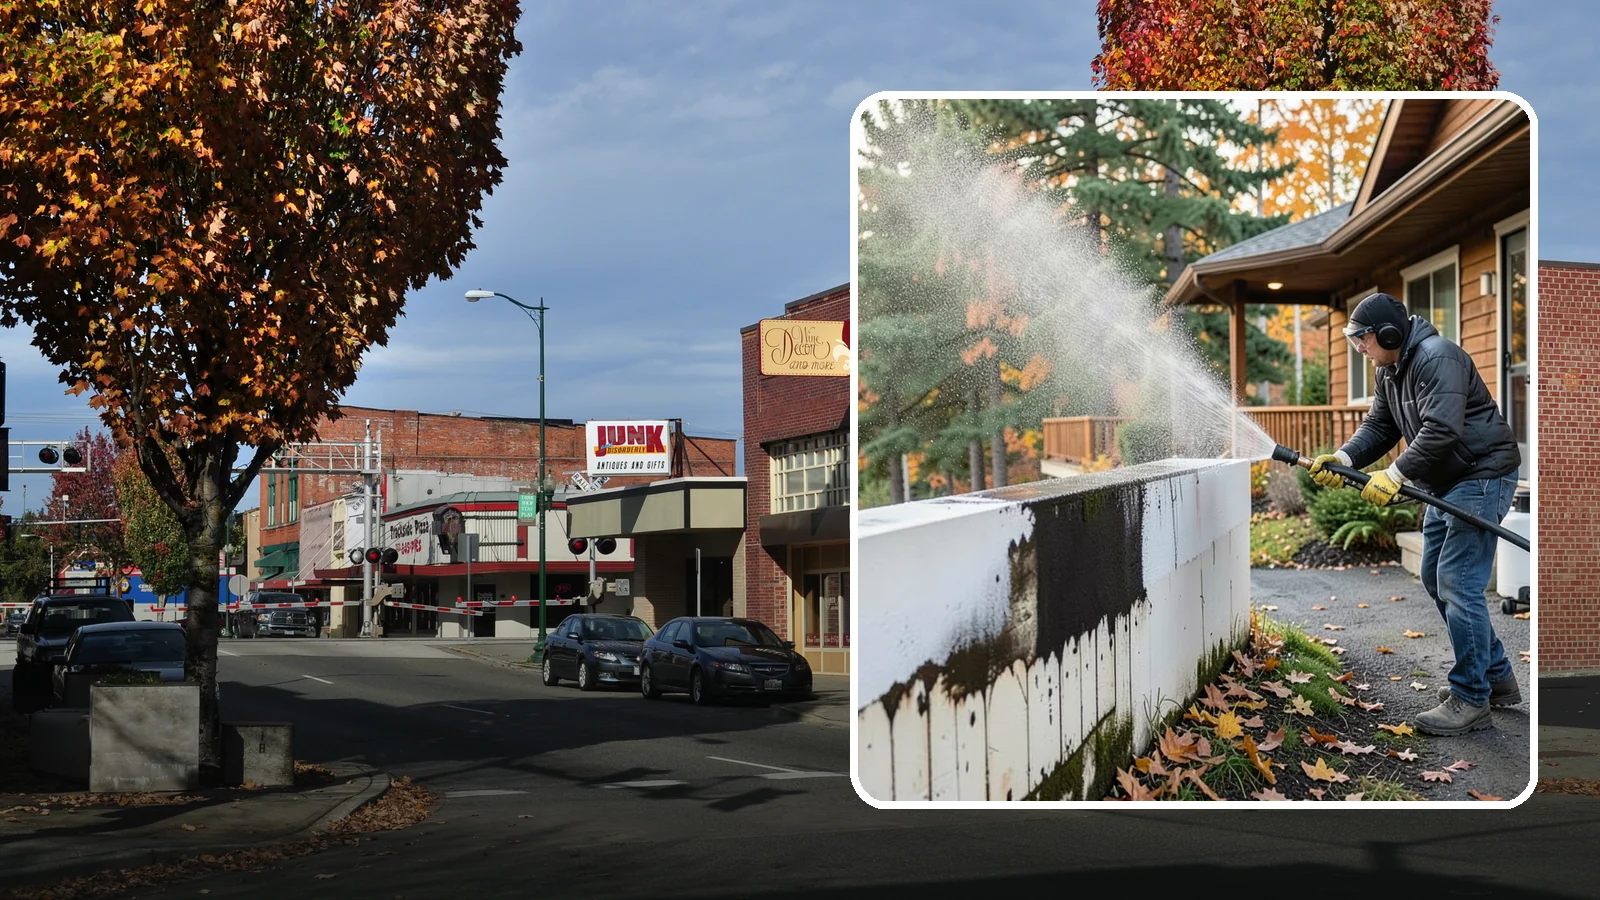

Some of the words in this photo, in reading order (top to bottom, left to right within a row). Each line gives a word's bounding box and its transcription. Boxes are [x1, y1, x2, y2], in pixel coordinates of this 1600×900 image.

[595, 425, 665, 457] JUNK
[607, 446, 646, 454] DISORDERLY
[597, 461, 628, 470] ANTIQUES
[631, 461, 644, 470] AND
[647, 460, 665, 470] GIFTS
[390, 521, 413, 539] Trackside
[414, 519, 429, 534] Pizza
